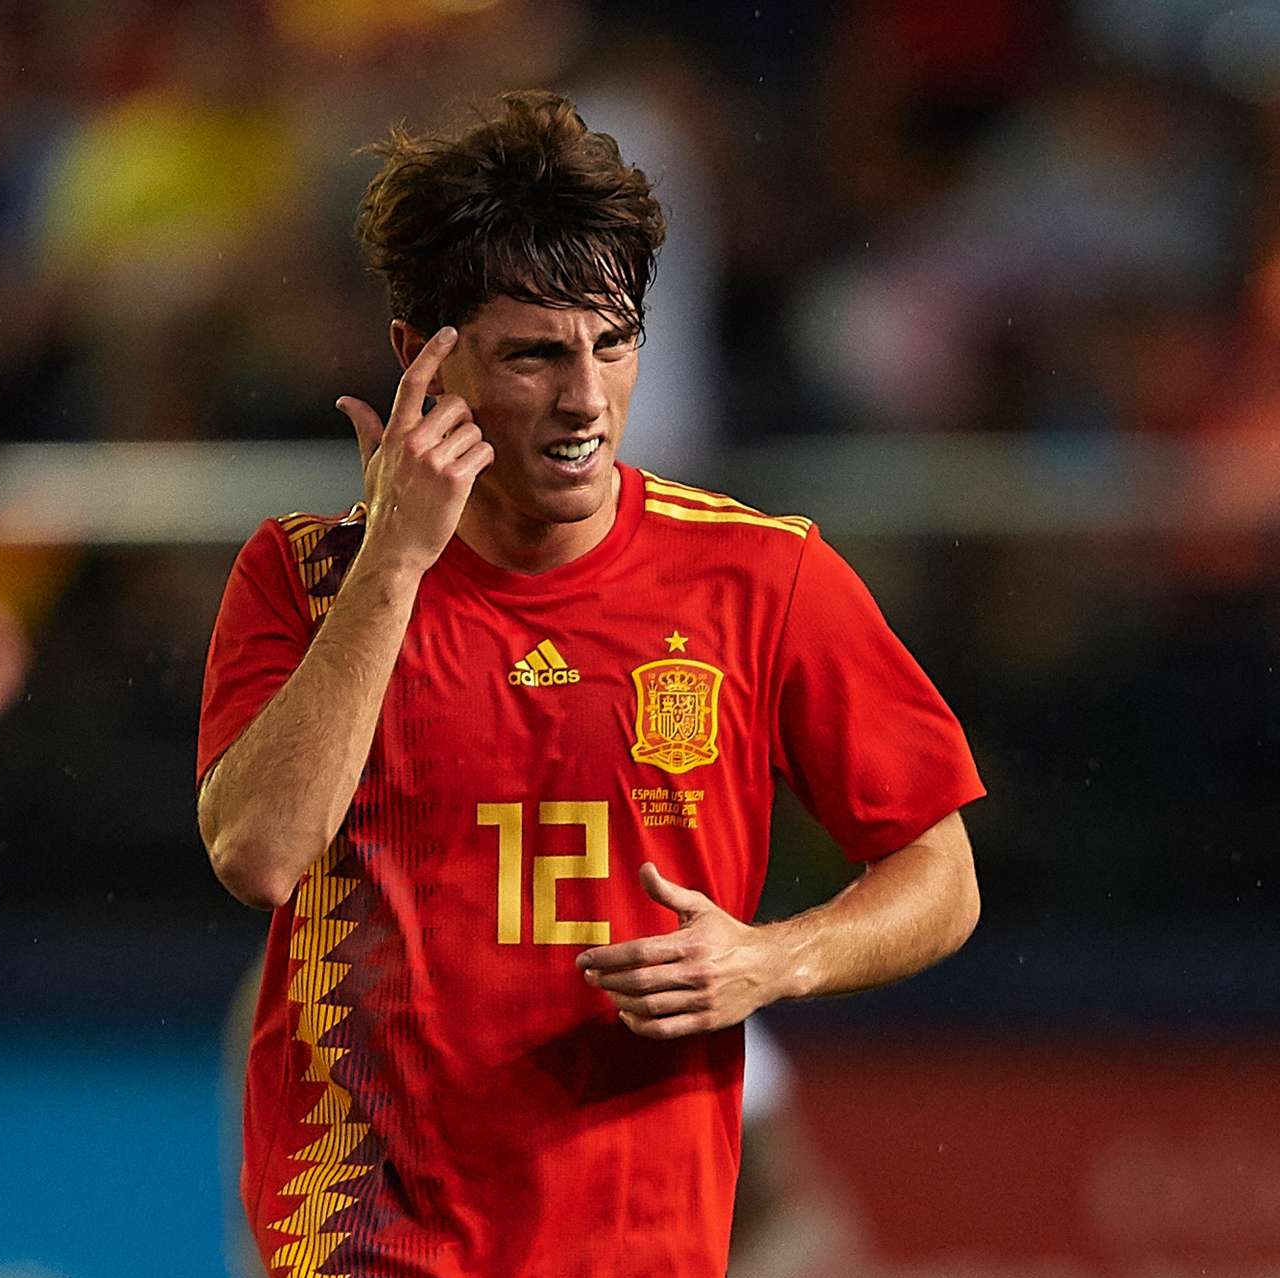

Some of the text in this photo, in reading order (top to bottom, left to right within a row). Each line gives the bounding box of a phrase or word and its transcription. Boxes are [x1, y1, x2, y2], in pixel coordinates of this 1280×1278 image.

[508, 668, 581, 688] adidas
[631, 786, 669, 801] ESPAÑA
[640, 802, 647, 814] 3
[649, 802, 680, 814] JUNIO
[477, 801, 610, 945] 12
